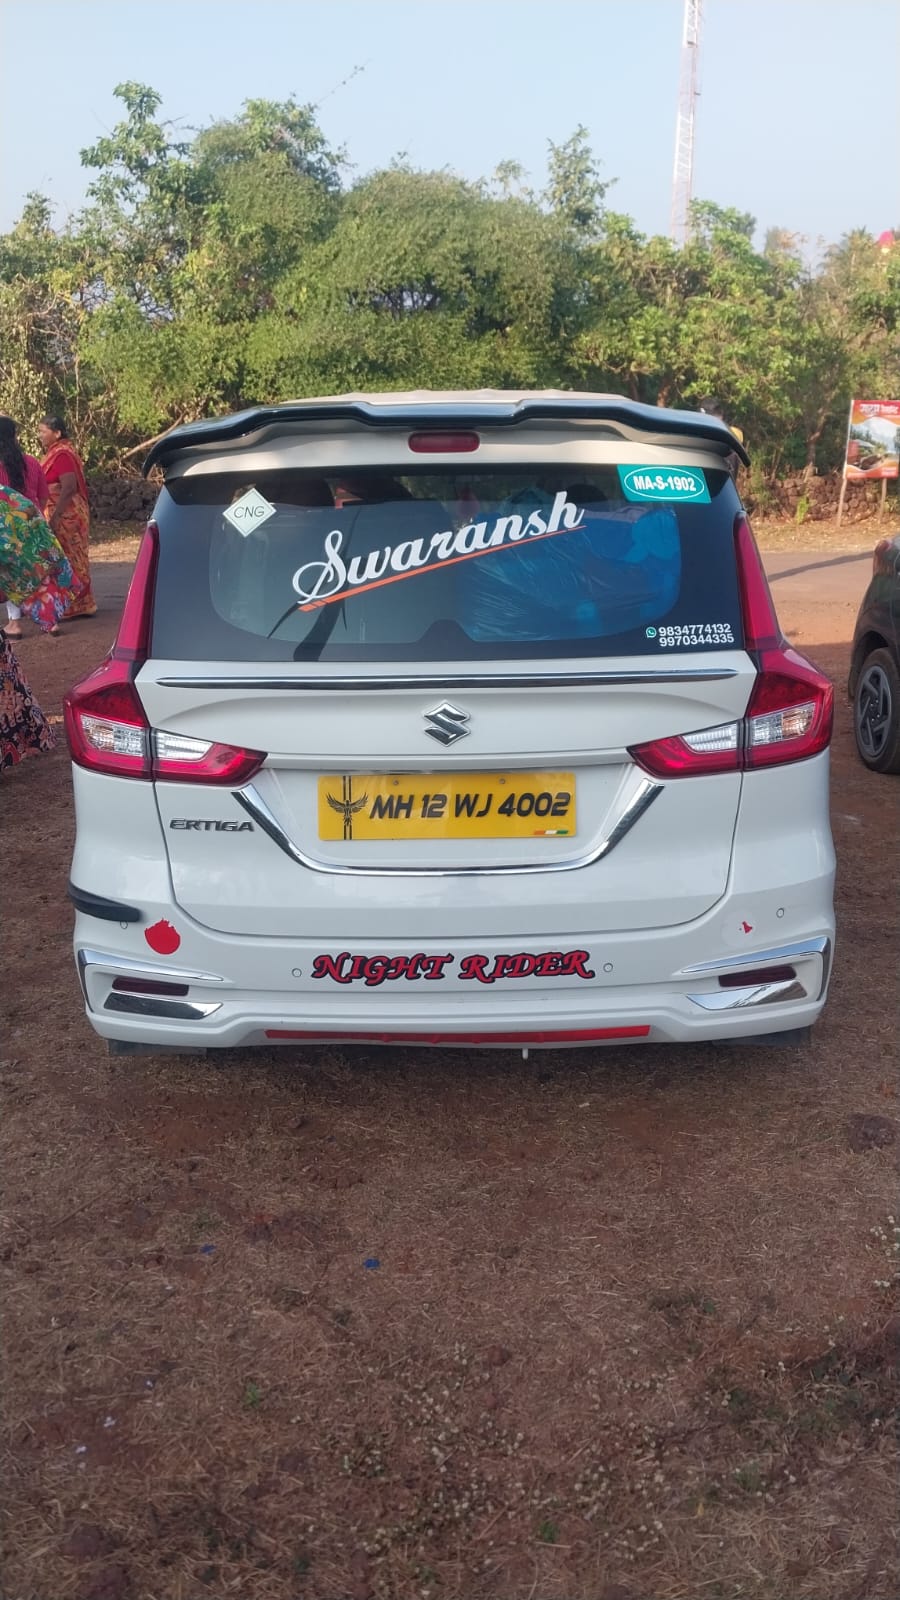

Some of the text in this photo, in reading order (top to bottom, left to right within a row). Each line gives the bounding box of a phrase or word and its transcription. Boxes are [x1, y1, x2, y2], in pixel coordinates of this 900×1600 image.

[633, 475, 697, 492] MA-S-1902
[233, 505, 265, 519] CNG
[292, 490, 585, 604] Swaransh
[658, 623, 732, 637] 9834774132
[659, 633, 735, 647] 9970344335
[369, 792, 571, 819] MH 12 WJ 4002
[169, 818, 254, 832] ERTIGA
[311, 950, 595, 986] NIGHT RIDER
